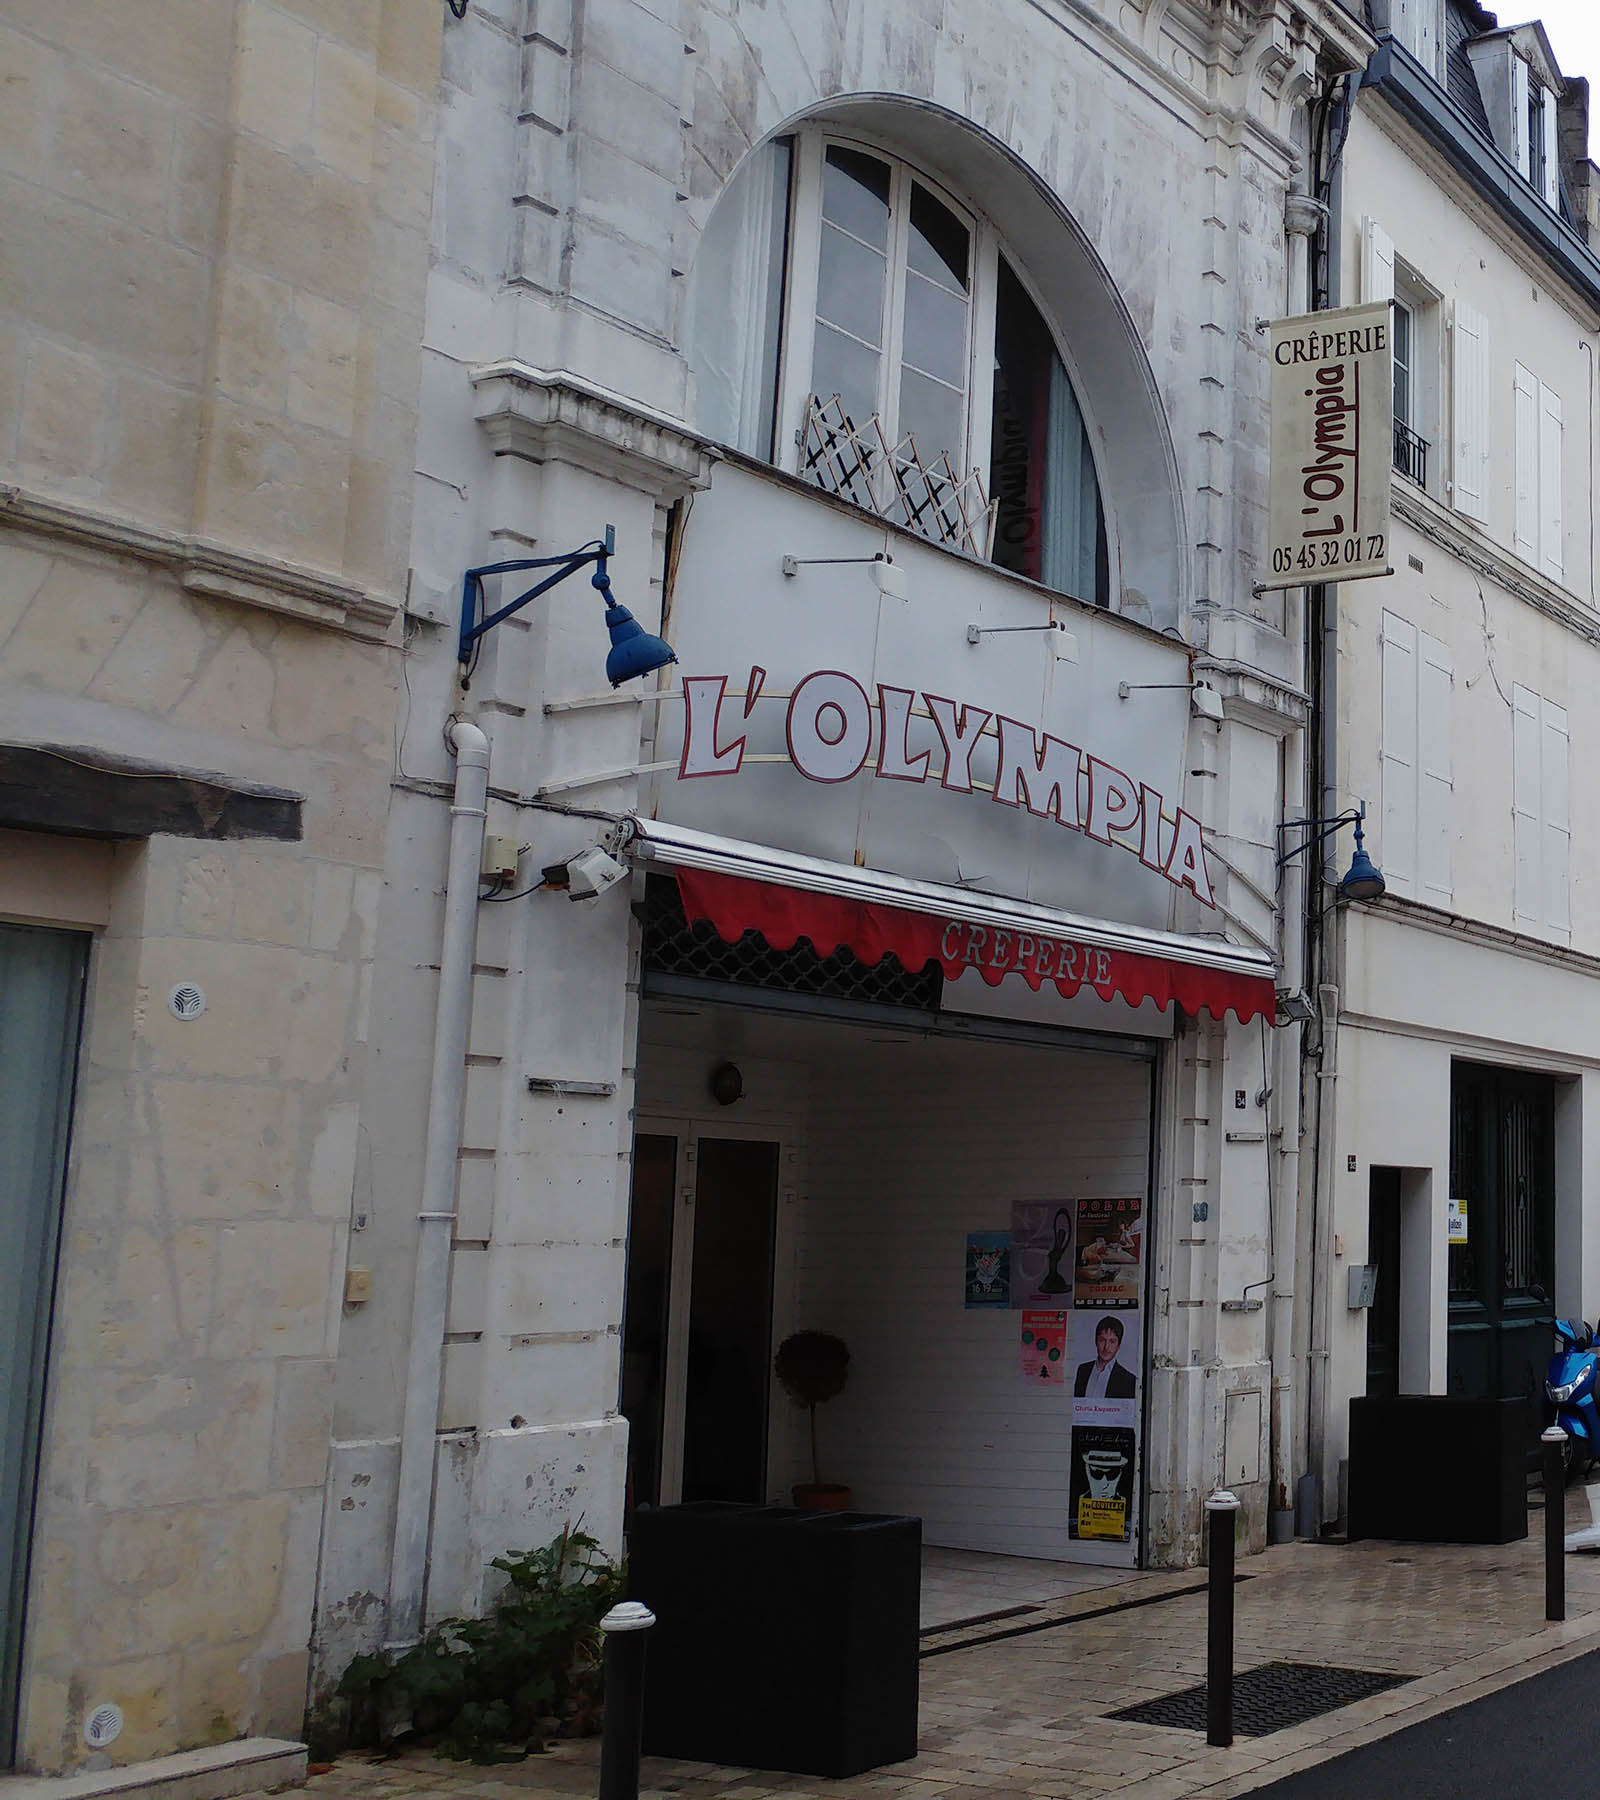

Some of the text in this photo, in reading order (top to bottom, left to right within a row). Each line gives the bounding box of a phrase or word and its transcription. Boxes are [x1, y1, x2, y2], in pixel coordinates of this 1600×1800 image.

[1274, 324, 1386, 366] CRÊPERIE
[1301, 363, 1358, 538] L'Olympia
[1273, 534, 1386, 573] 05 45 32 01 72
[677, 665, 1216, 911] L'OLYMPIA
[941, 920, 1113, 985] CREPERIE
[1079, 1200, 1141, 1211] POLAR
